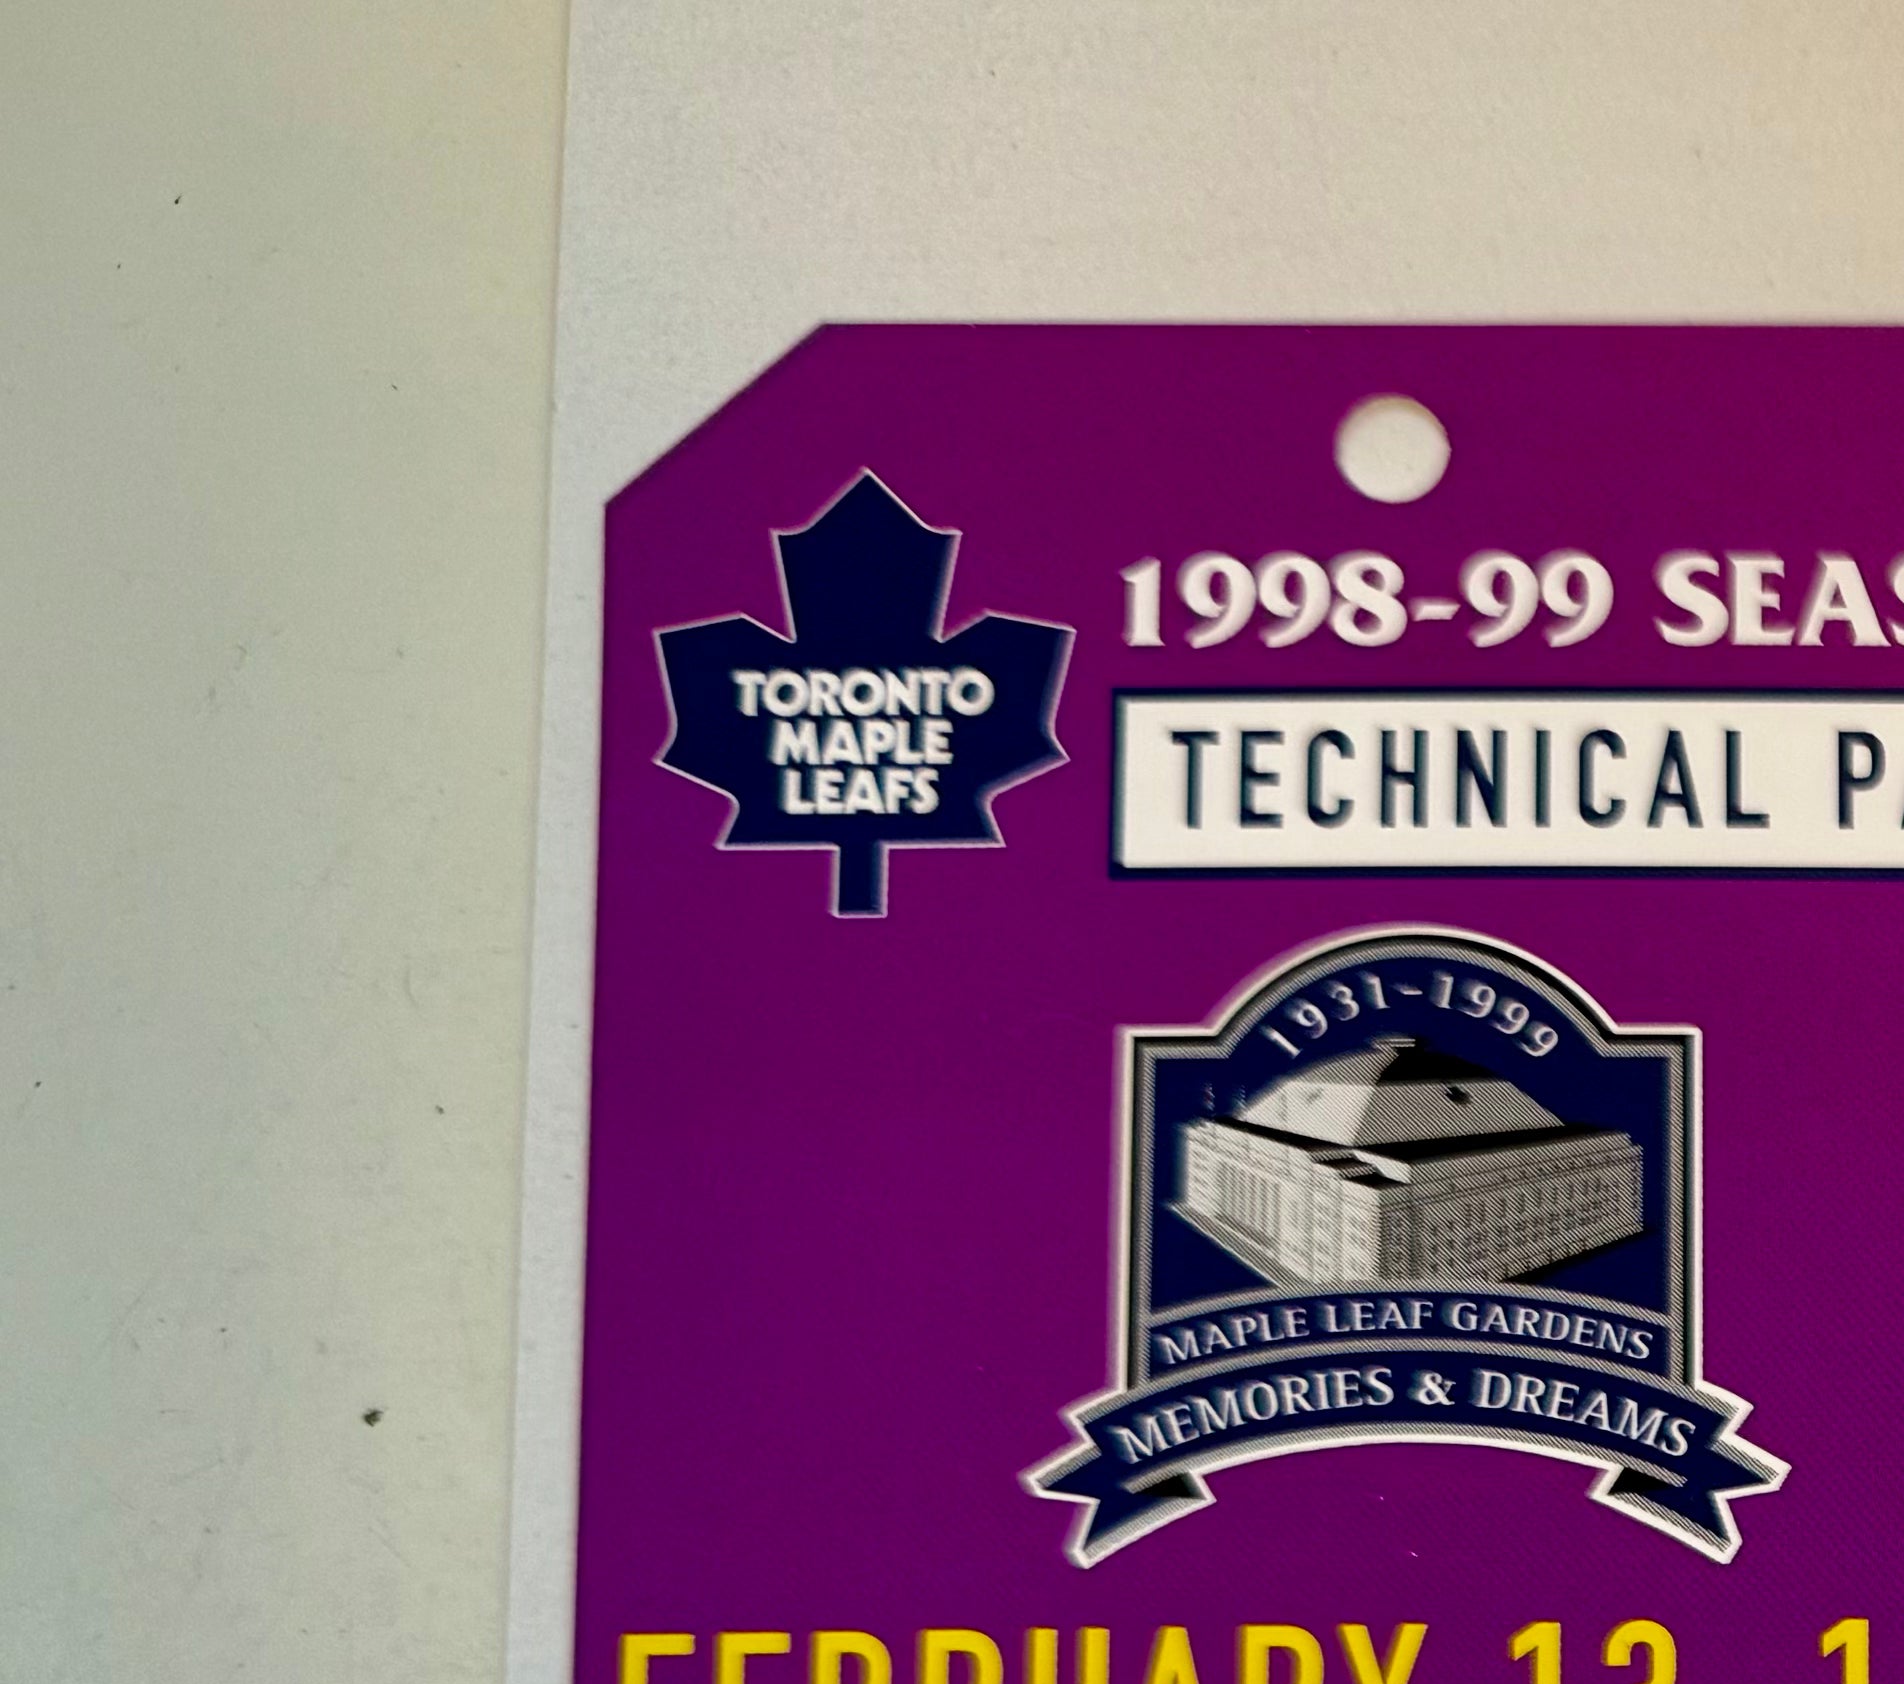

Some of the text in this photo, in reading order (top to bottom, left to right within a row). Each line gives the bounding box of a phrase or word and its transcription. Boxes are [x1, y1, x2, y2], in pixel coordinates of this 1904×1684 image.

[1120, 551, 1613, 653] 1998-99
[736, 668, 995, 719] TORONTO
[767, 717, 952, 768] MAPLE
[1169, 729, 1770, 830] TECHNICAL
[784, 767, 941, 817] LEAFS
[1266, 973, 1560, 1062] 1931-1999
[1155, 1297, 1654, 1364] MAPLE LEAF GARDENS
[1116, 1364, 1698, 1465] MEMORIES & DREAMS
